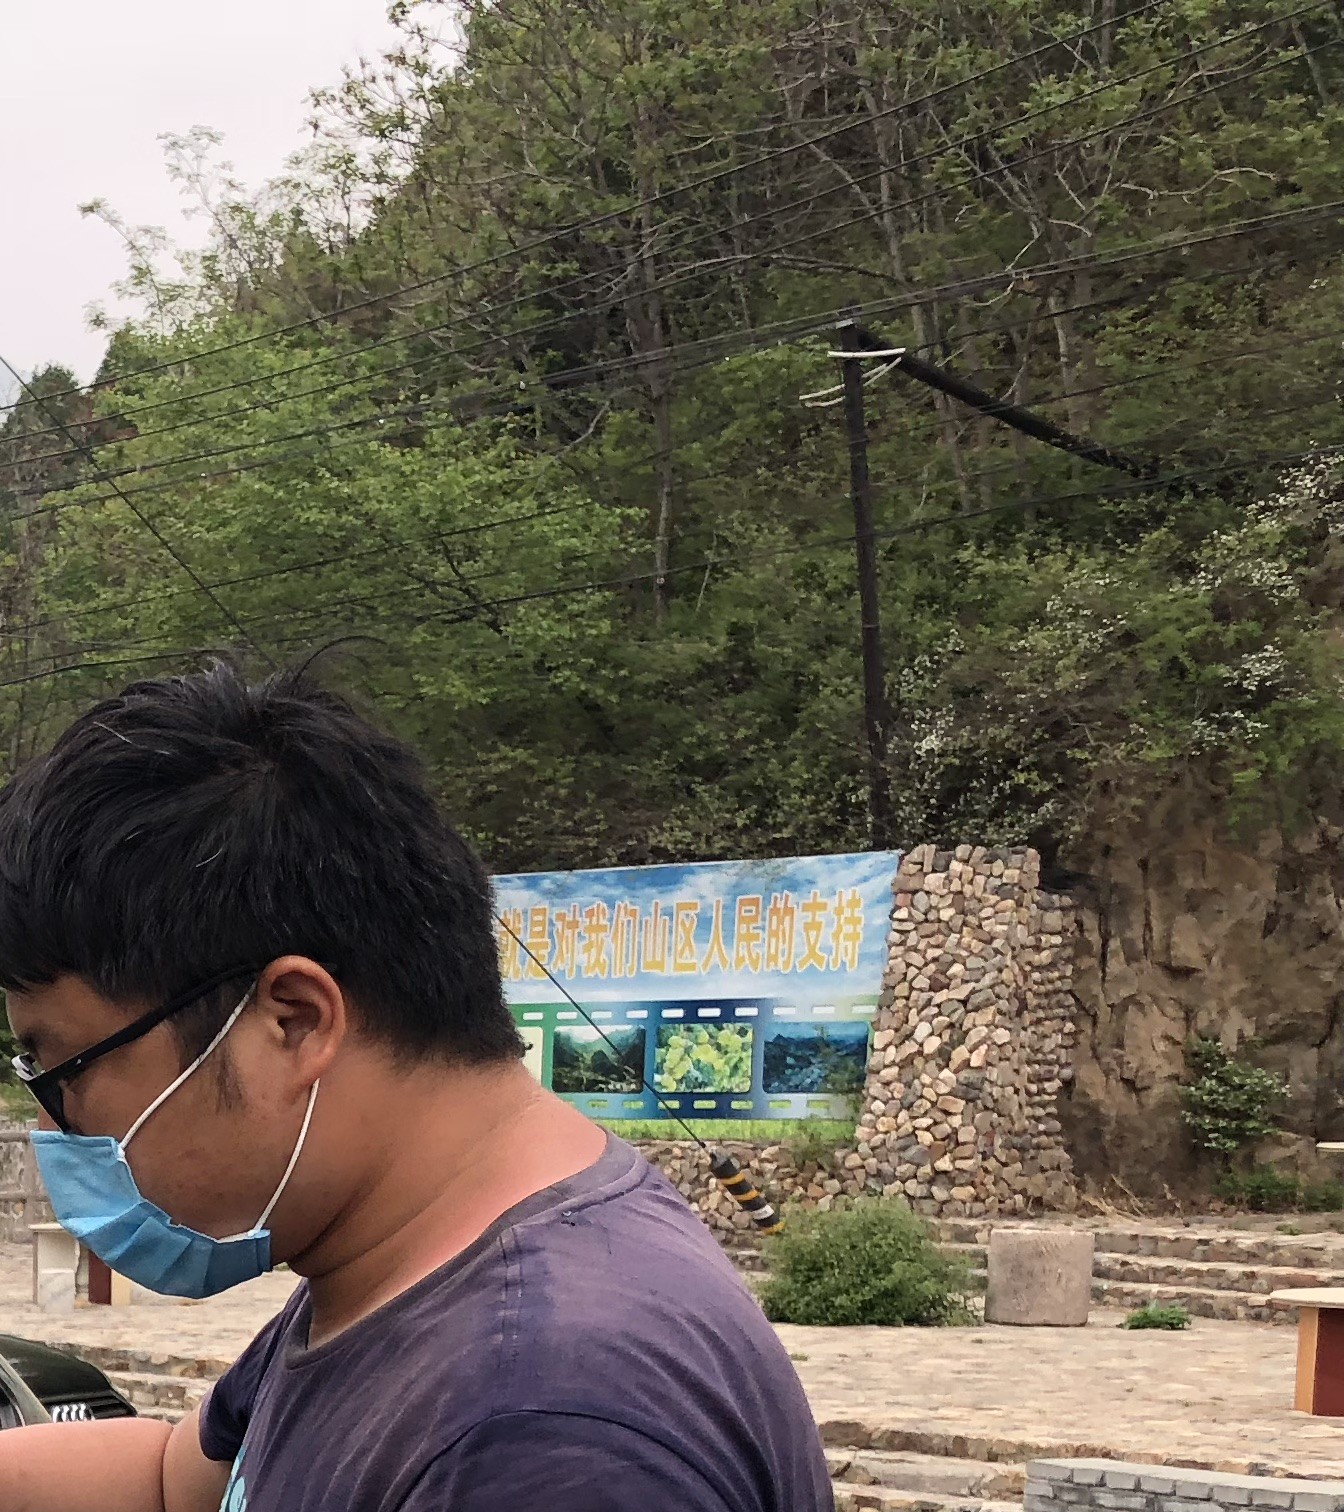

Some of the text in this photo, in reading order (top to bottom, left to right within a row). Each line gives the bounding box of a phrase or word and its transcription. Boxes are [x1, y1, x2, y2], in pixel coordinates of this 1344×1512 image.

[498, 888, 864, 980] 就是对我们山区人民的支持
